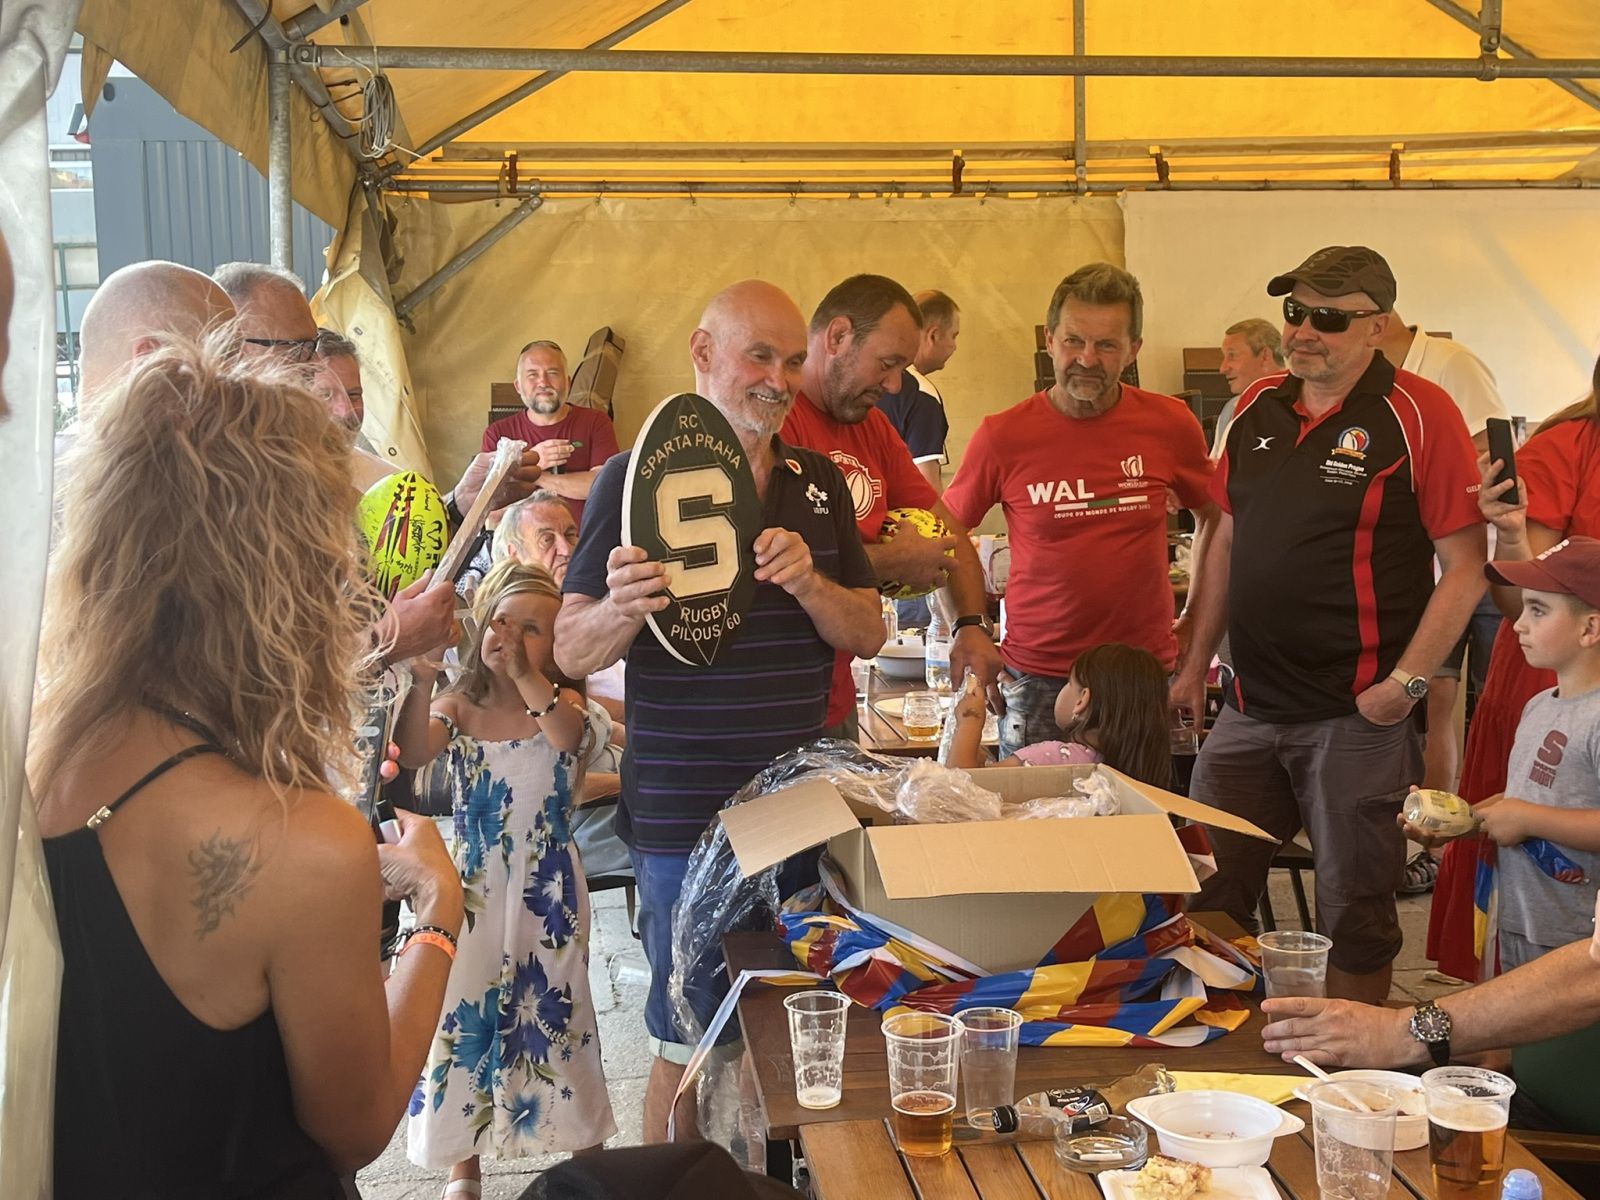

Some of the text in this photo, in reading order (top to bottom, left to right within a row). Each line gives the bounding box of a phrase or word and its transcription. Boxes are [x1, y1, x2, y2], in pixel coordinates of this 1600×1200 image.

[679, 414, 698, 429] RC
[640, 433, 742, 480] SPARTA PRAHA
[1026, 479, 1095, 505] WAL
[655, 465, 741, 600] S
[680, 598, 729, 624] RUGBY
[670, 612, 741, 642] PILOUS 60
[1537, 729, 1568, 766] S
